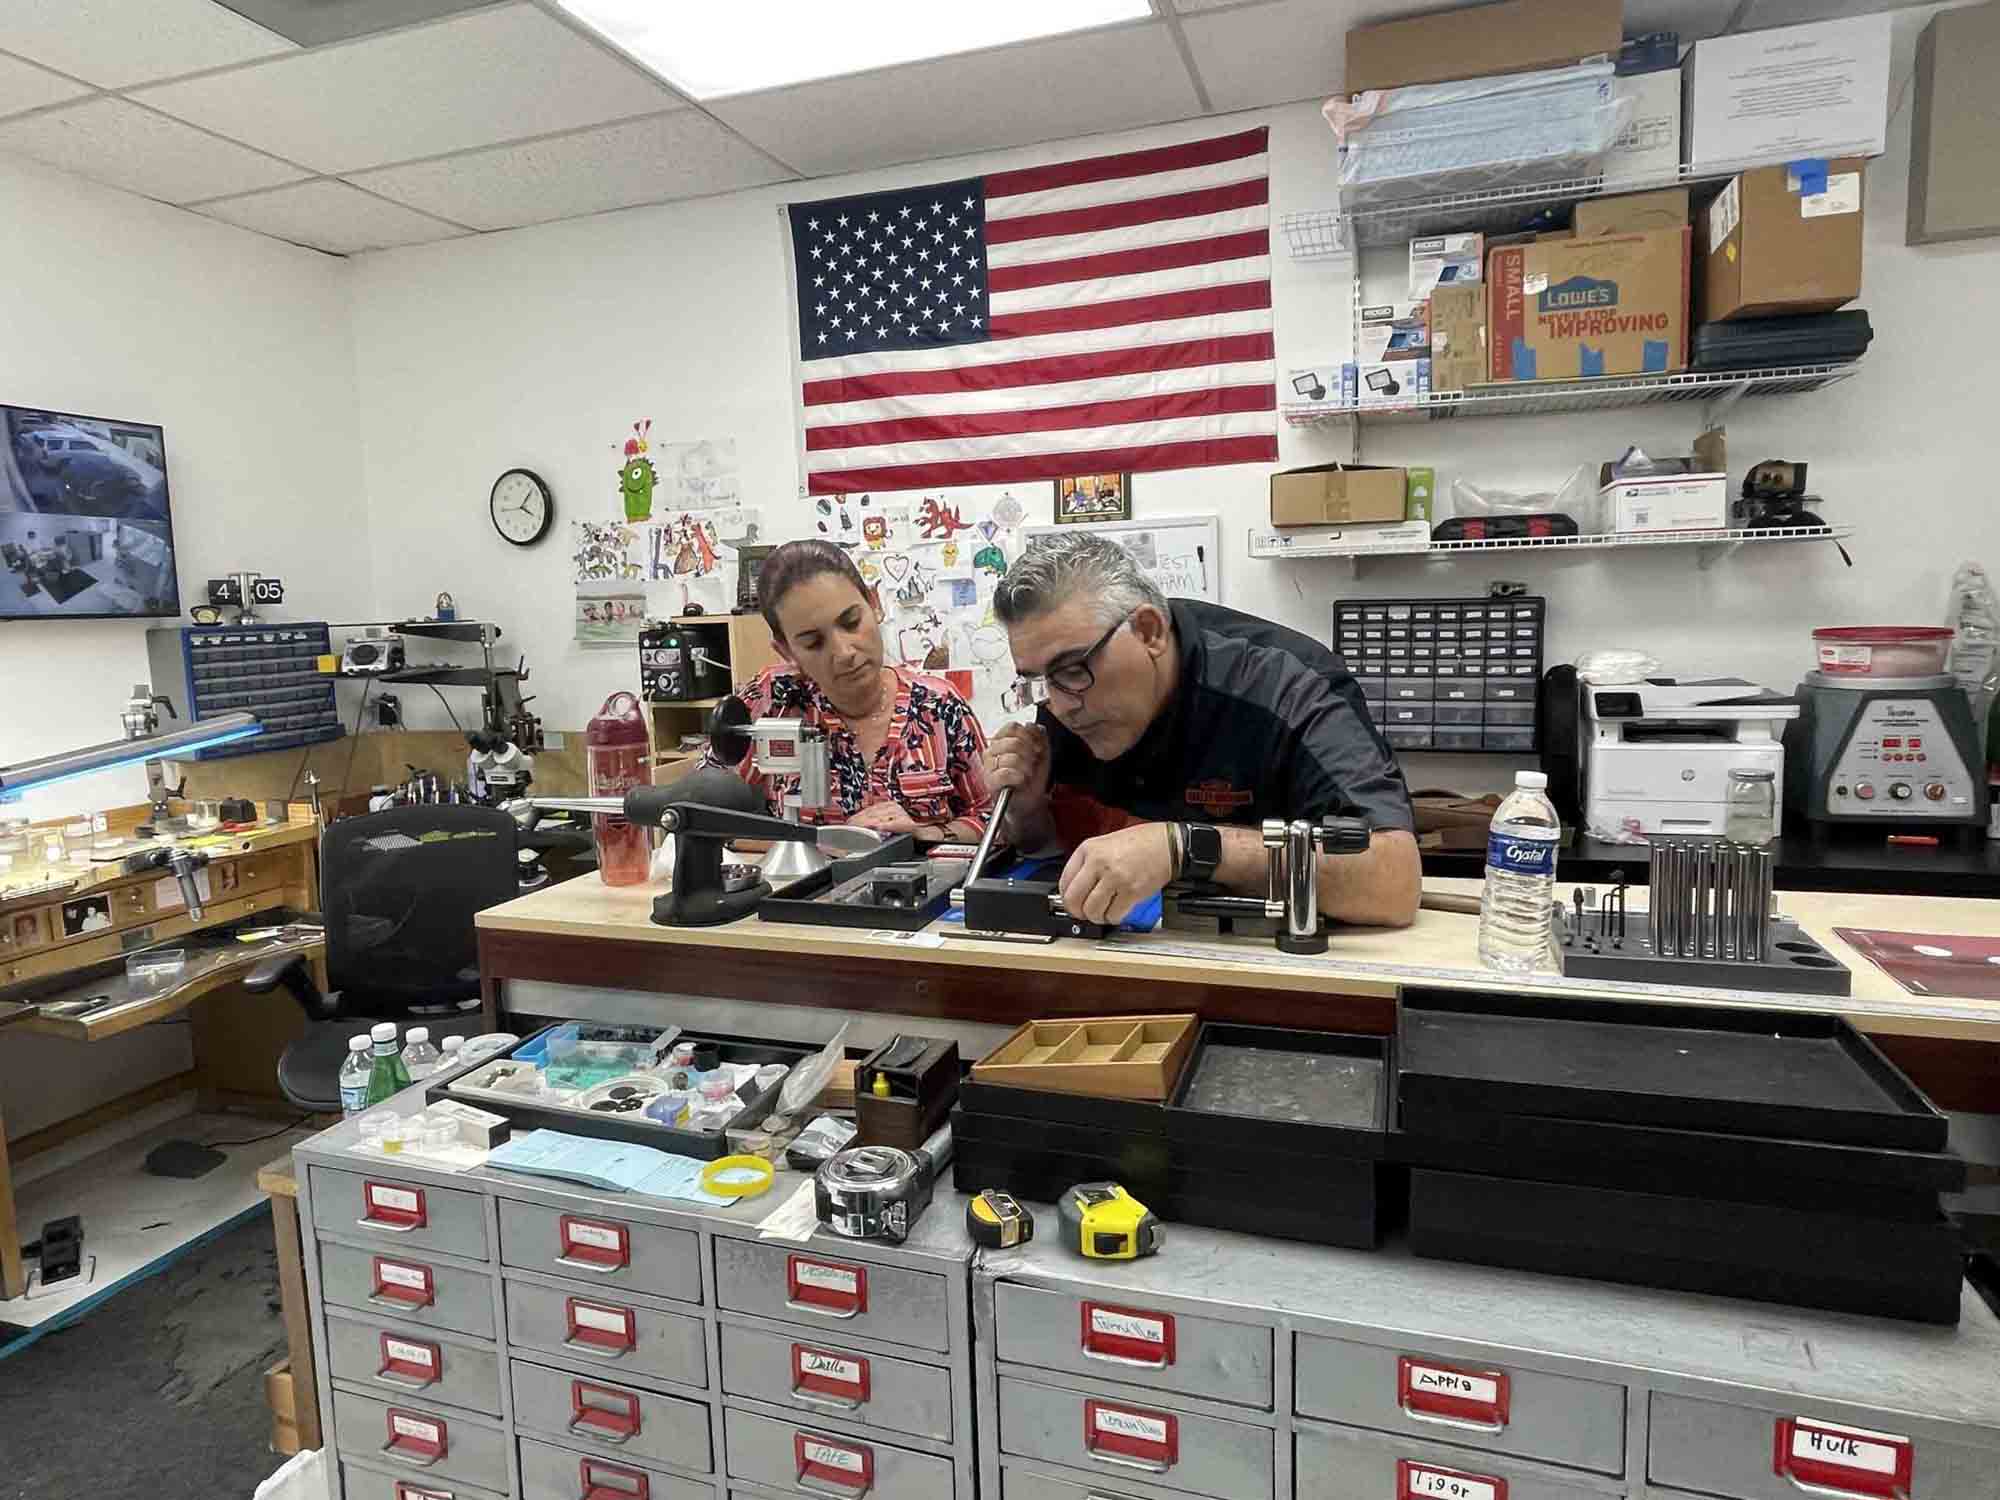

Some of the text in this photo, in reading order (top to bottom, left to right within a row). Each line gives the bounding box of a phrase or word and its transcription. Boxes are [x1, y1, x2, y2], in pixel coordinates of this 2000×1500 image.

[1505, 254, 1521, 320] SMALL
[1537, 308, 1617, 326] NEVER STOP
[1550, 312, 1669, 339] IMPROVING
[216, 582, 281, 600] 4 05
[1506, 845, 1547, 863] Crystal
